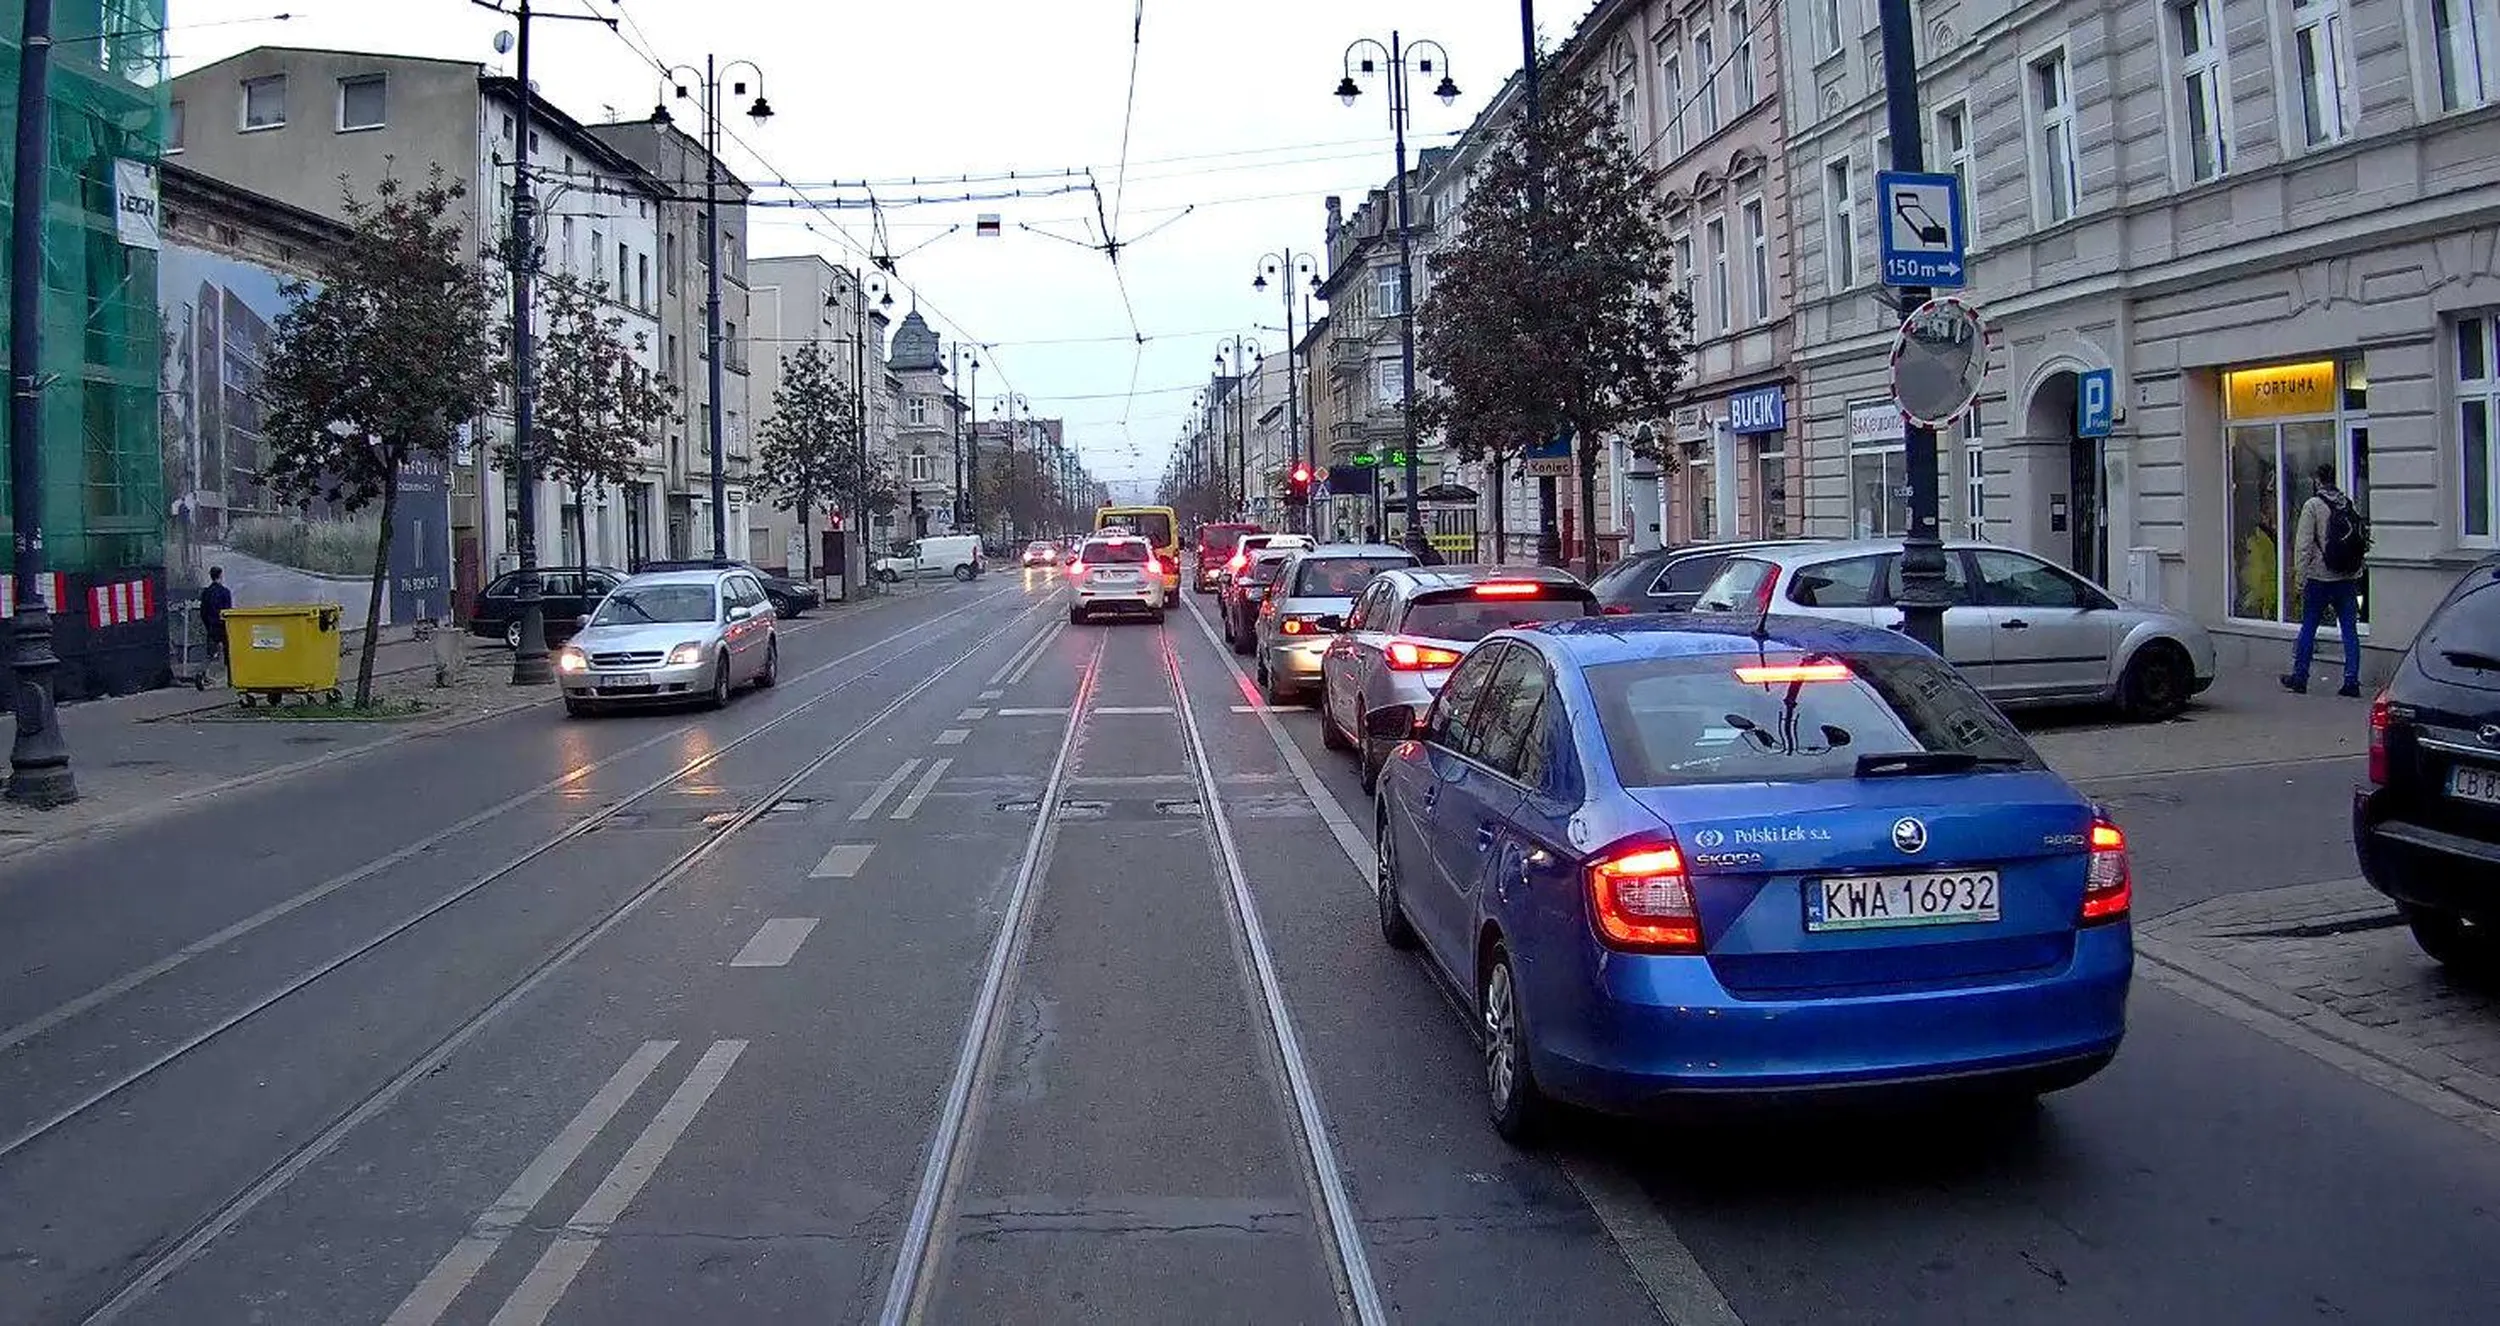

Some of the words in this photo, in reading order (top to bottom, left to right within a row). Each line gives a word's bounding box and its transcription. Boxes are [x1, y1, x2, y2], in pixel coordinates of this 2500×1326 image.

[120, 191, 155, 218] LECH
[2254, 378, 2315, 397] FORTUNA
[1731, 393, 1776, 429] BUCIK
[2086, 378, 2104, 428] P
[2485, 774, 2500, 800] 8
[1734, 828, 1777, 844] Polski
[1781, 825, 1806, 841] Lek
[1826, 882, 1889, 919] KWA
[1904, 876, 1995, 914] 16932
